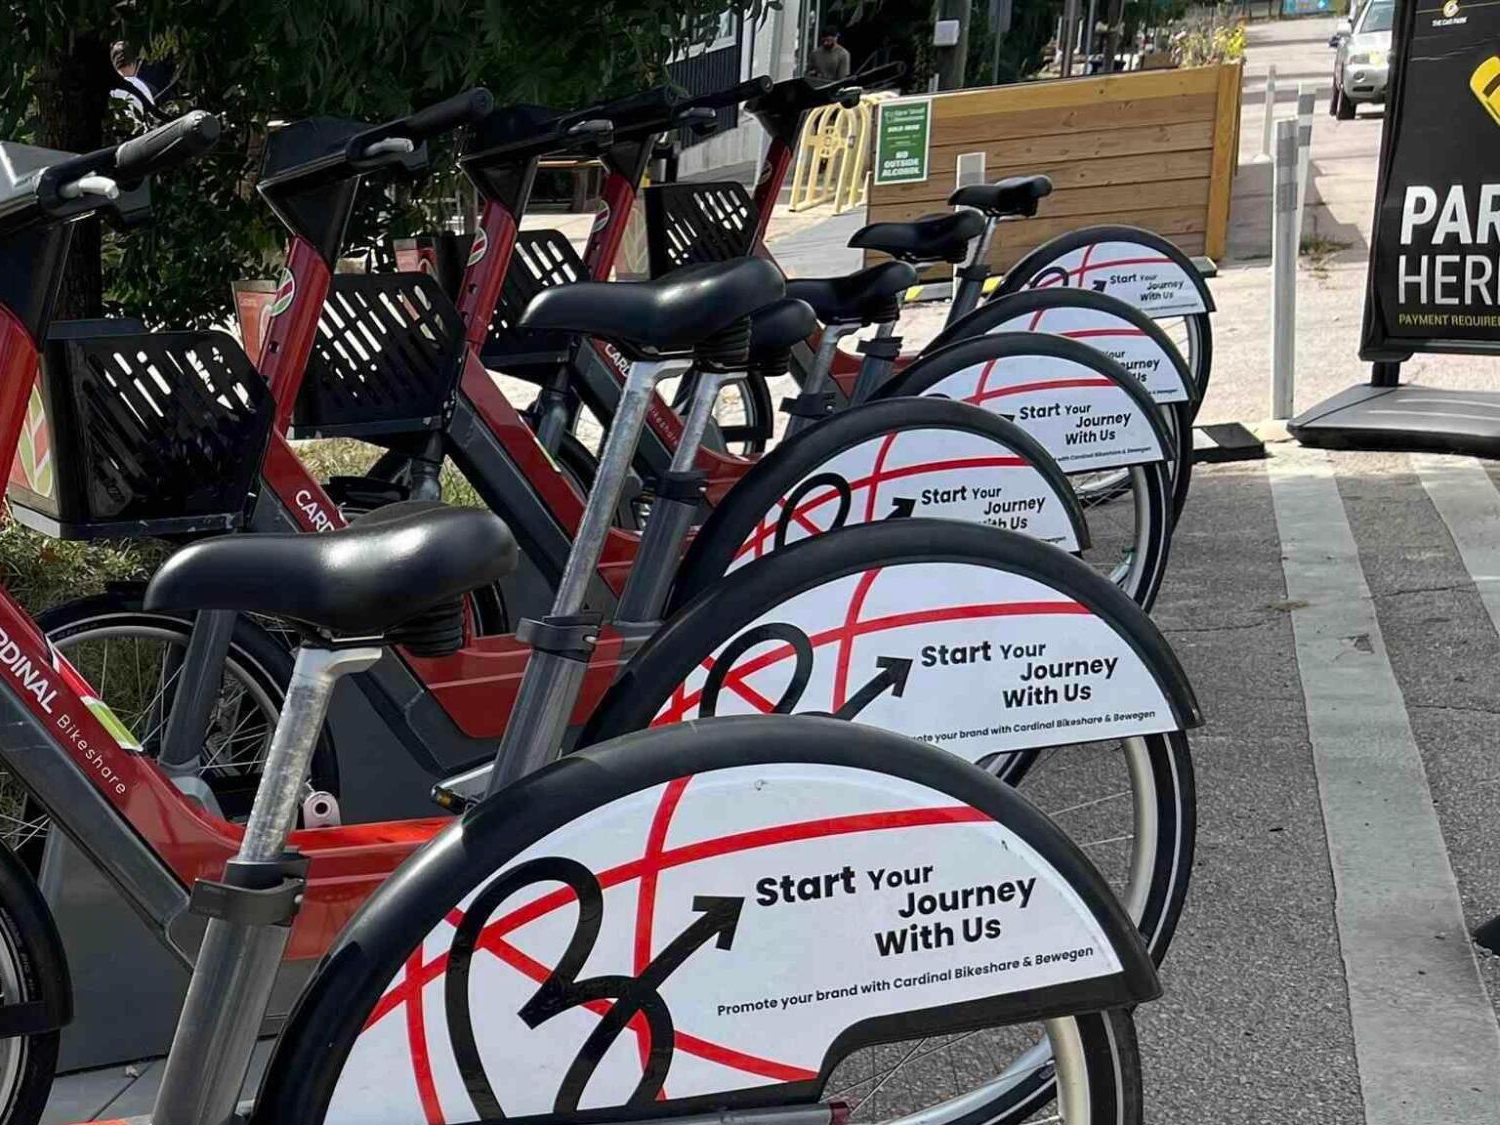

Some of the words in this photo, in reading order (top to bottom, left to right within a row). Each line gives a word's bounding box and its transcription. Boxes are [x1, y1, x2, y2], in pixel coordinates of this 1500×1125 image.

[884, 158, 920, 168] OUTSIDE
[1400, 184, 1500, 245] PAR
[1110, 274, 1137, 284] Start
[1147, 281, 1184, 290] Journey
[1398, 254, 1500, 305] HER
[1140, 292, 1161, 301] With
[1398, 314, 1450, 326] PAYMENT
[1120, 359, 1160, 371] ourney
[1020, 403, 1061, 420] Start
[1065, 405, 1092, 415] Your
[1076, 413, 1132, 428] Journey
[1066, 430, 1097, 445] With
[1100, 429, 1116, 441] Us
[921, 486, 967, 505] Start
[972, 488, 1001, 499] Your
[984, 497, 1045, 515] Journey
[1010, 516, 1028, 529] Us
[921, 641, 991, 667] Start
[1000, 642, 1046, 660] Your
[1020, 657, 1118, 681] Journey
[1002, 685, 1058, 709] With
[1063, 683, 1092, 701] Us
[934, 732, 958, 743] your
[960, 728, 989, 740] brand
[990, 725, 1012, 735] with
[1013, 720, 1055, 733] Cardinal
[1056, 715, 1103, 729] Bikeshare
[1113, 710, 1156, 723] Bewegen
[56, 714, 126, 794] Bikeshare
[755, 865, 857, 907] Start
[866, 864, 934, 891] Your
[897, 877, 1037, 918] Journey
[873, 924, 955, 958] With
[961, 919, 1001, 943] Us
[717, 998, 778, 1016] Promote
[780, 995, 814, 1010] your
[815, 984, 858, 1002] brand
[860, 980, 891, 994] with
[893, 970, 953, 989] Cardinal
[954, 959, 1021, 980] Bikeshare
[1022, 957, 1033, 967] &
[1034, 946, 1095, 966] Bewegen
